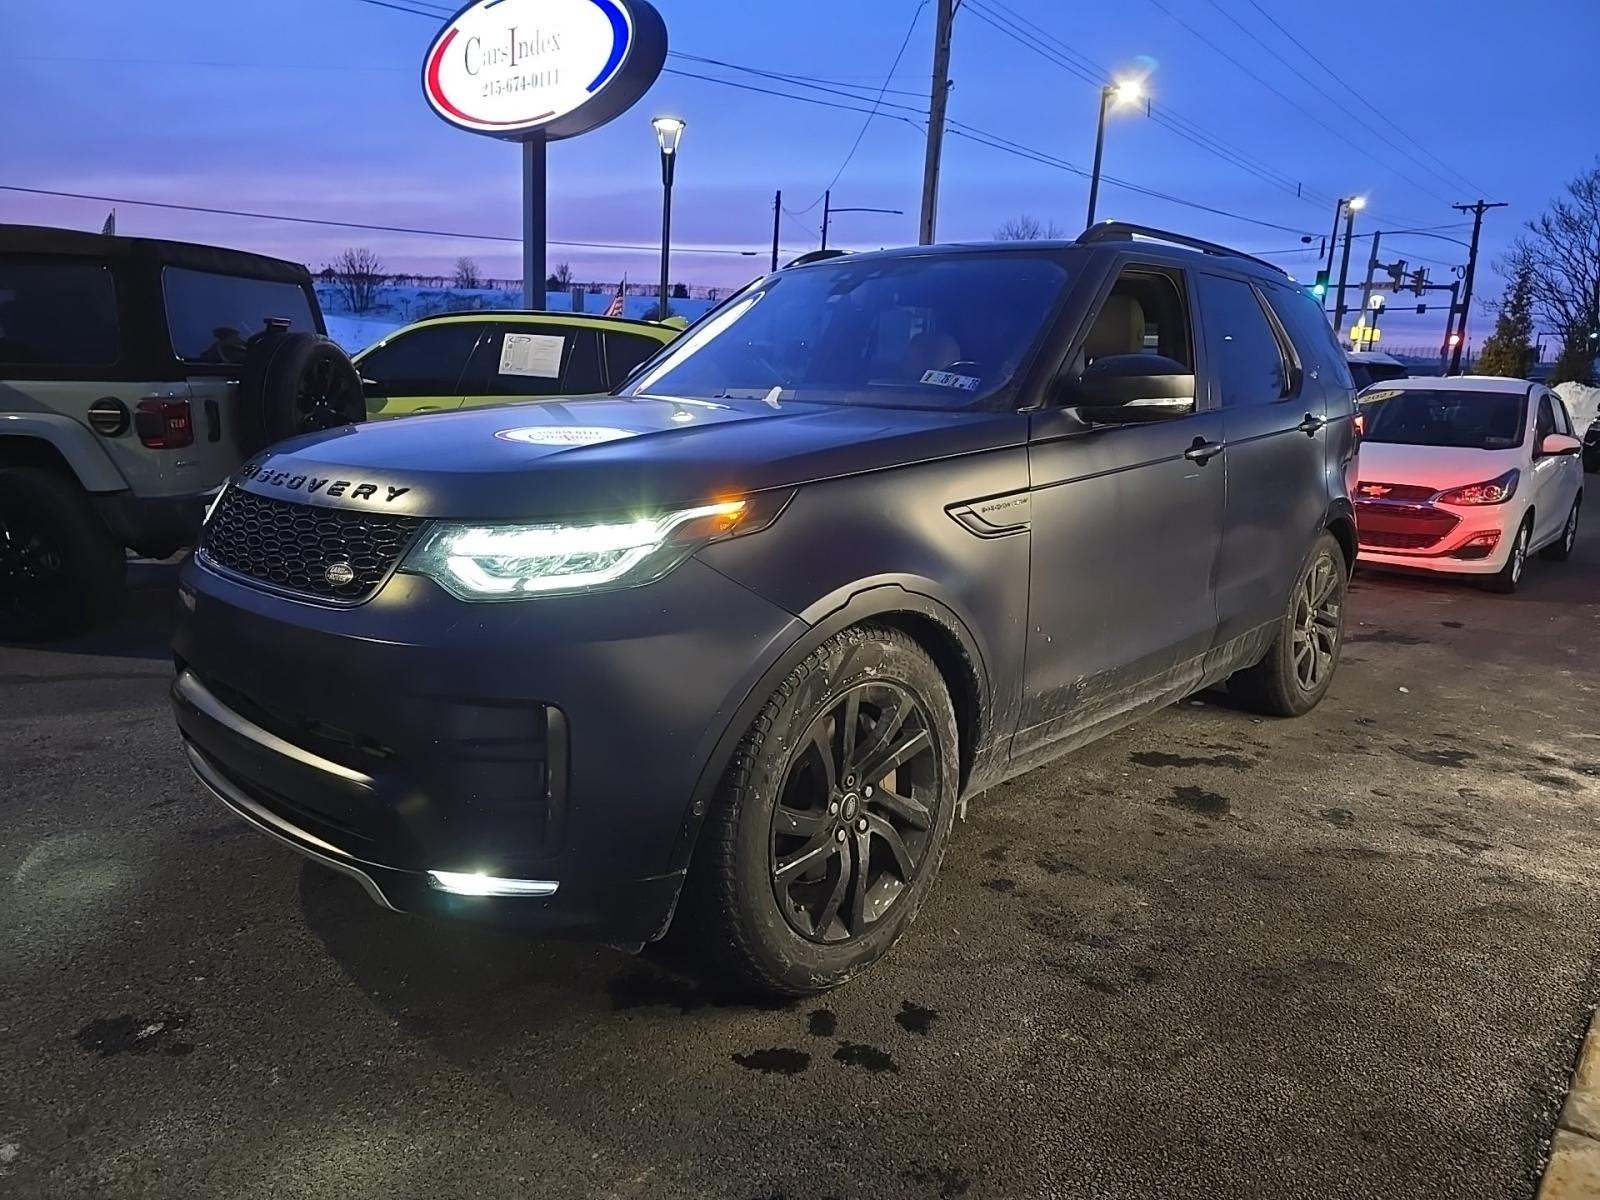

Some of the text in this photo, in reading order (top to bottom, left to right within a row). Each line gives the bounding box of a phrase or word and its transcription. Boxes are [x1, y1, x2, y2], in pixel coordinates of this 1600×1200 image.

[465, 26, 560, 76] CarsIndex
[482, 68, 559, 98] 215-674-0111
[242, 463, 410, 503] DISCOVERY
